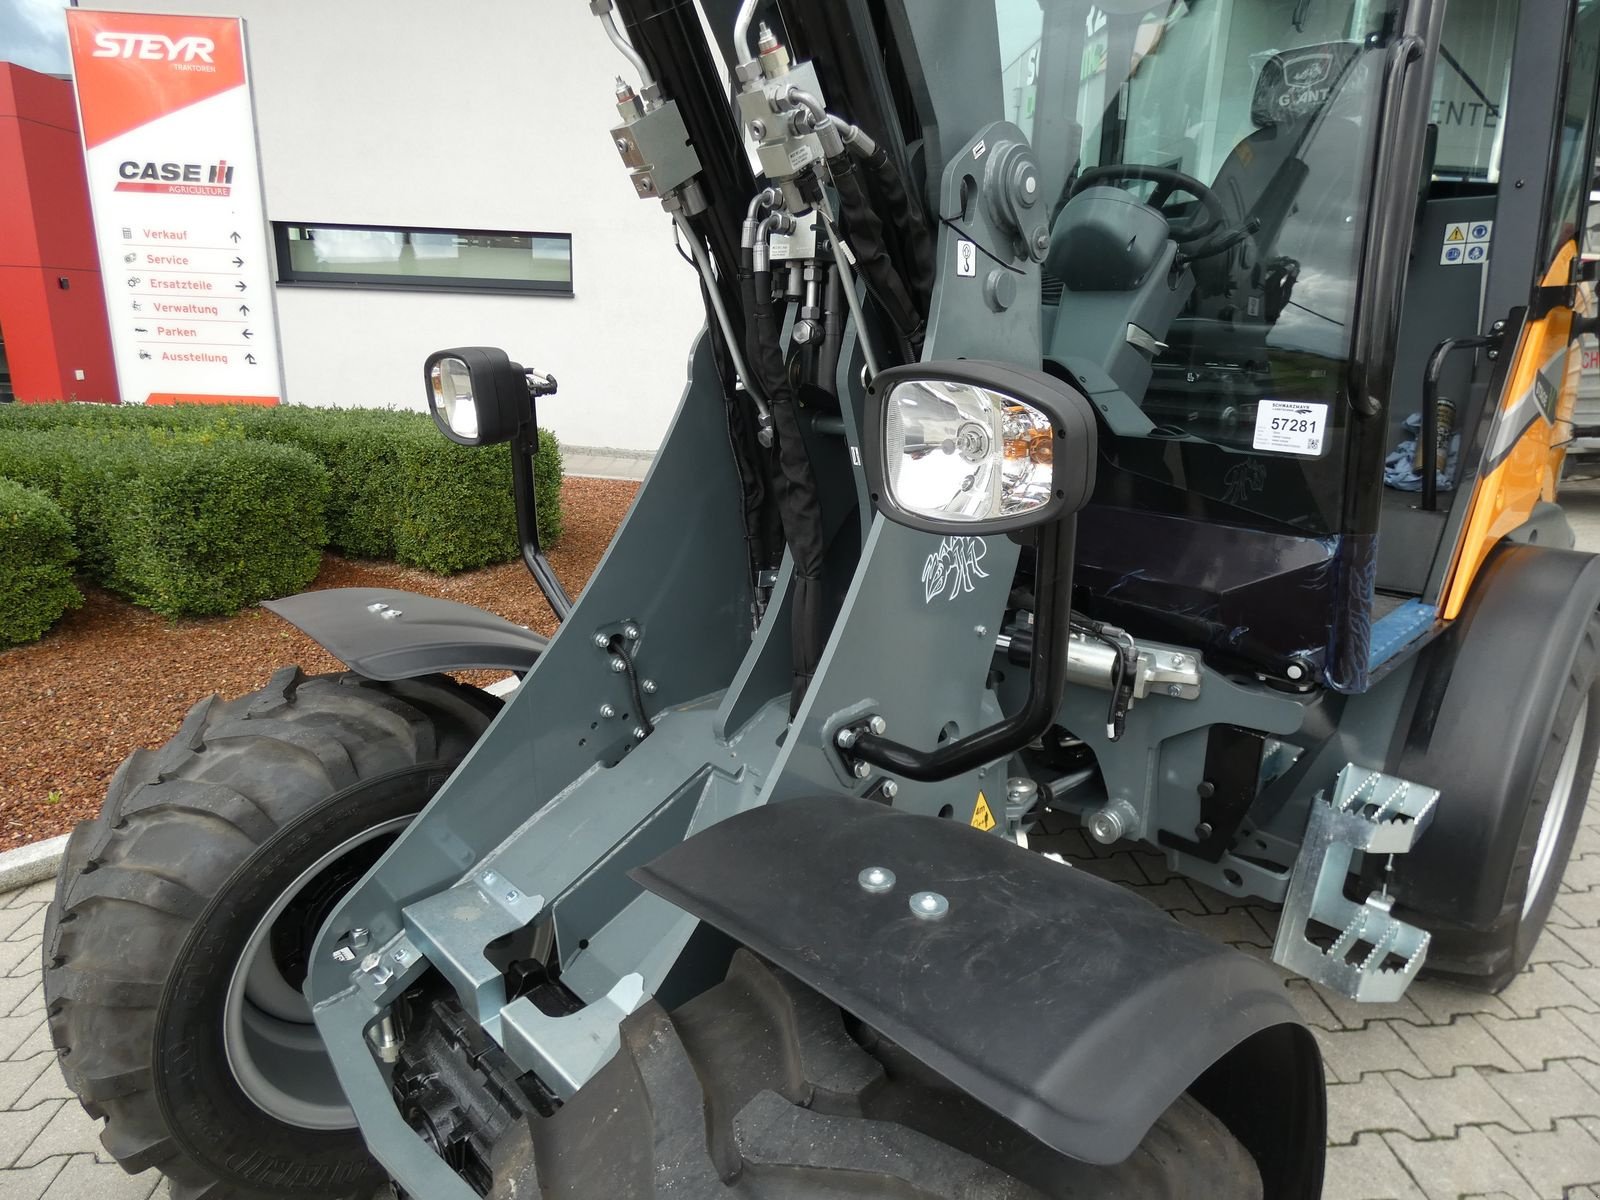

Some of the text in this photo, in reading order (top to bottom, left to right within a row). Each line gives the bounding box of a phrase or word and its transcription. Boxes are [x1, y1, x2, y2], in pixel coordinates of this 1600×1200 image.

[93, 32, 214, 63] STEYR
[174, 63, 216, 73] TRAKTOREN
[118, 160, 202, 183] CASE
[168, 185, 229, 197] AGRICULTURE
[143, 228, 188, 242] Verkauf
[146, 254, 189, 266] Service
[149, 278, 213, 291] Ersatzteile
[153, 302, 218, 316] Verwaltung
[157, 326, 197, 338] Parken
[162, 350, 228, 365] Ausstellung
[1271, 417, 1317, 434] 57281
